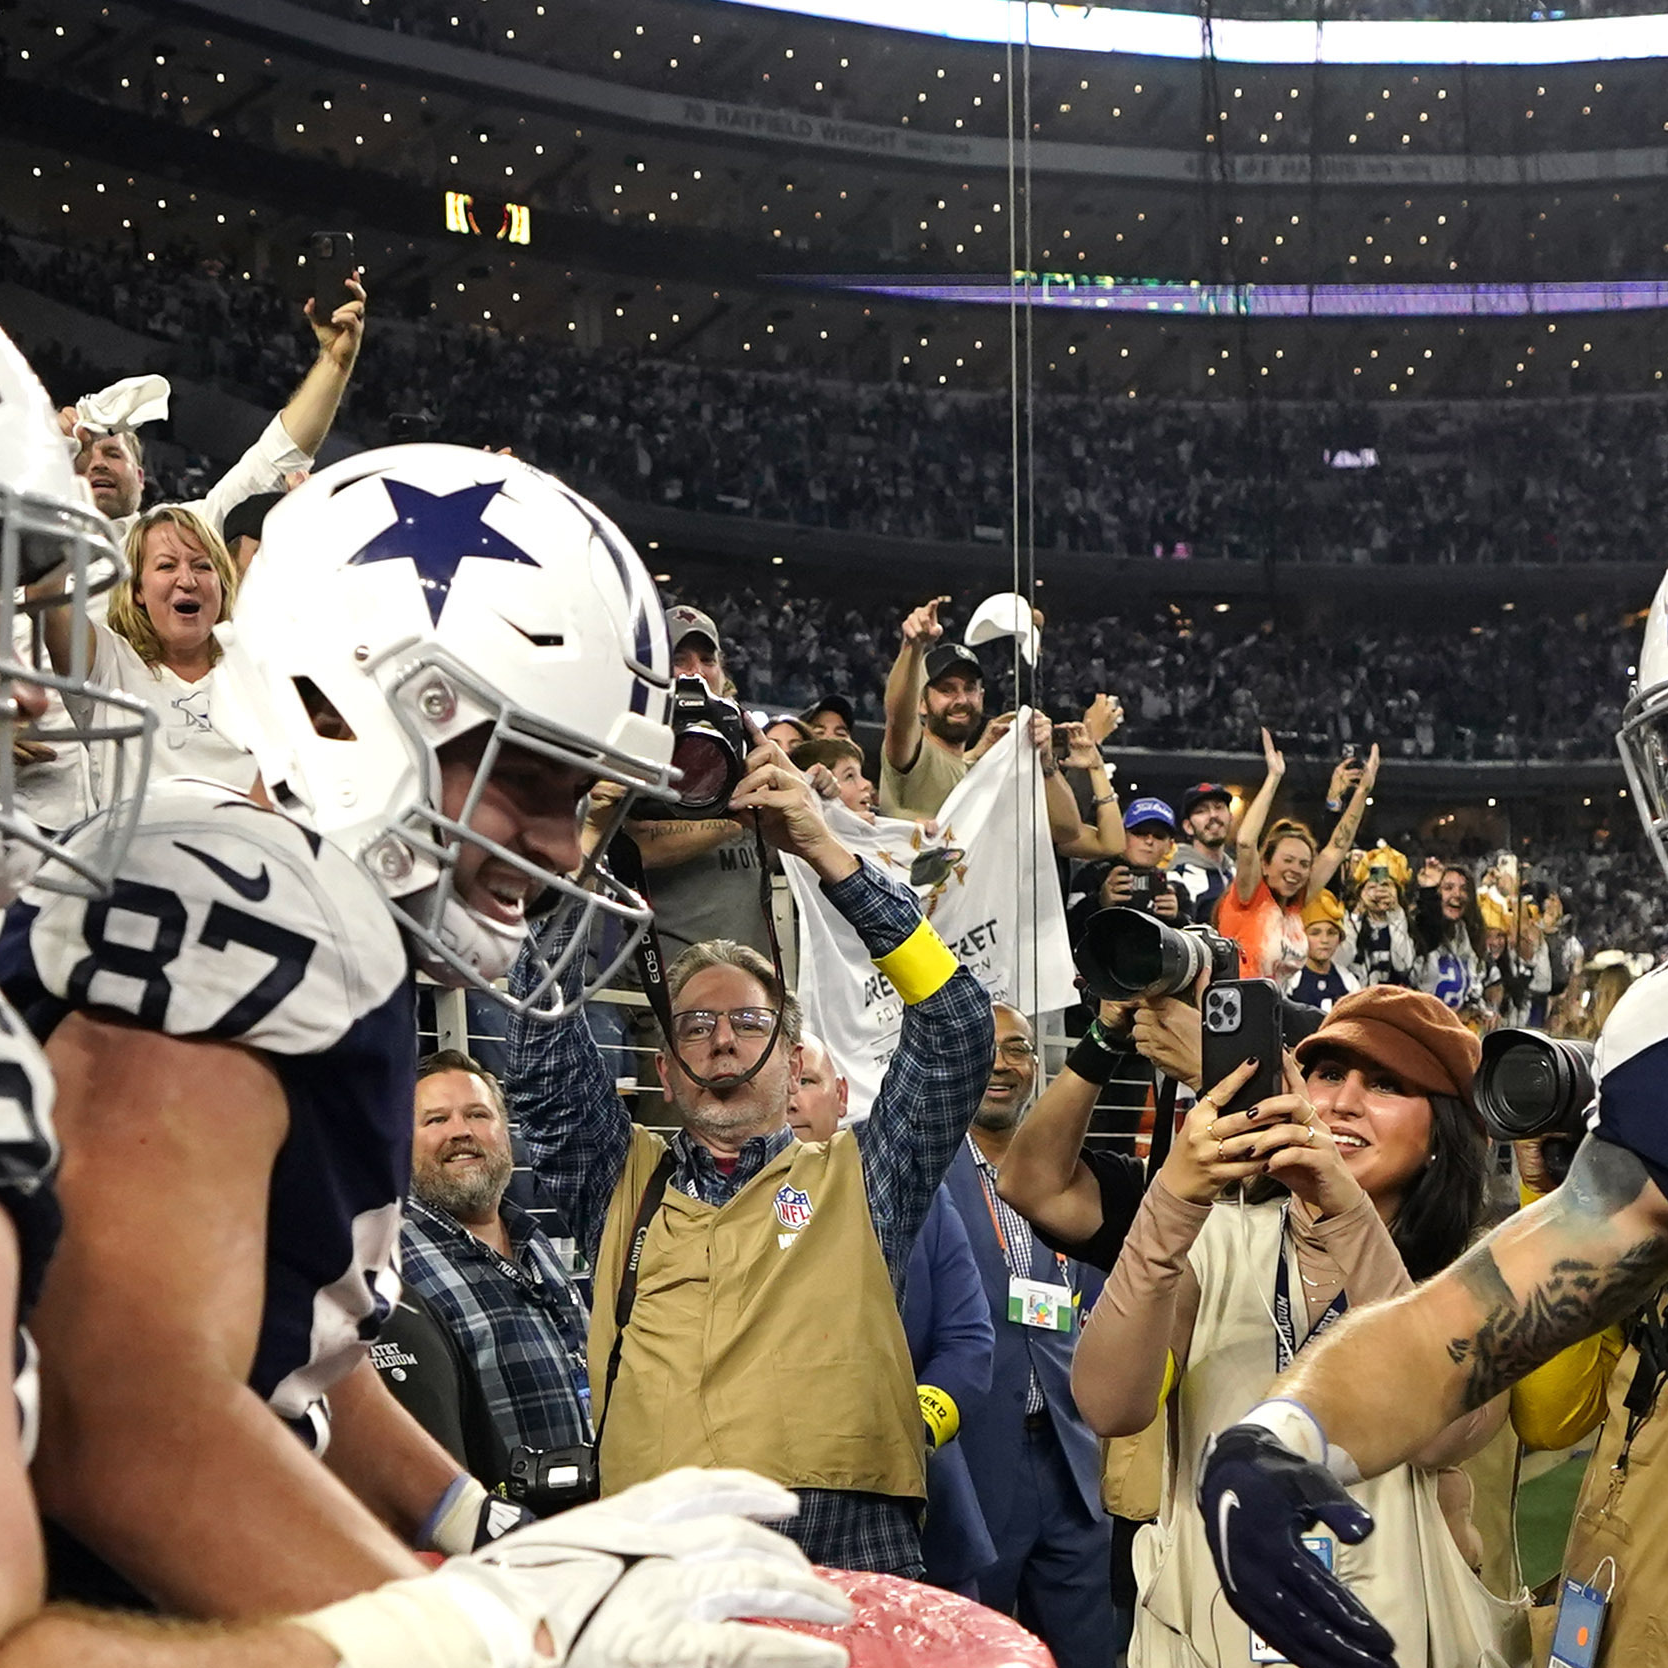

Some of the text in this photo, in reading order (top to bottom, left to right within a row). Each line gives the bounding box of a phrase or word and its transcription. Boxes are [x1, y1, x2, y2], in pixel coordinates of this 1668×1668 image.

[66, 879, 318, 1036] 87
[645, 950, 662, 985] EOS
[780, 1203, 811, 1223] NFL
[629, 1226, 648, 1271] Canon
[371, 1342, 401, 1358] AT&T
[371, 1351, 418, 1370] TADIUM
